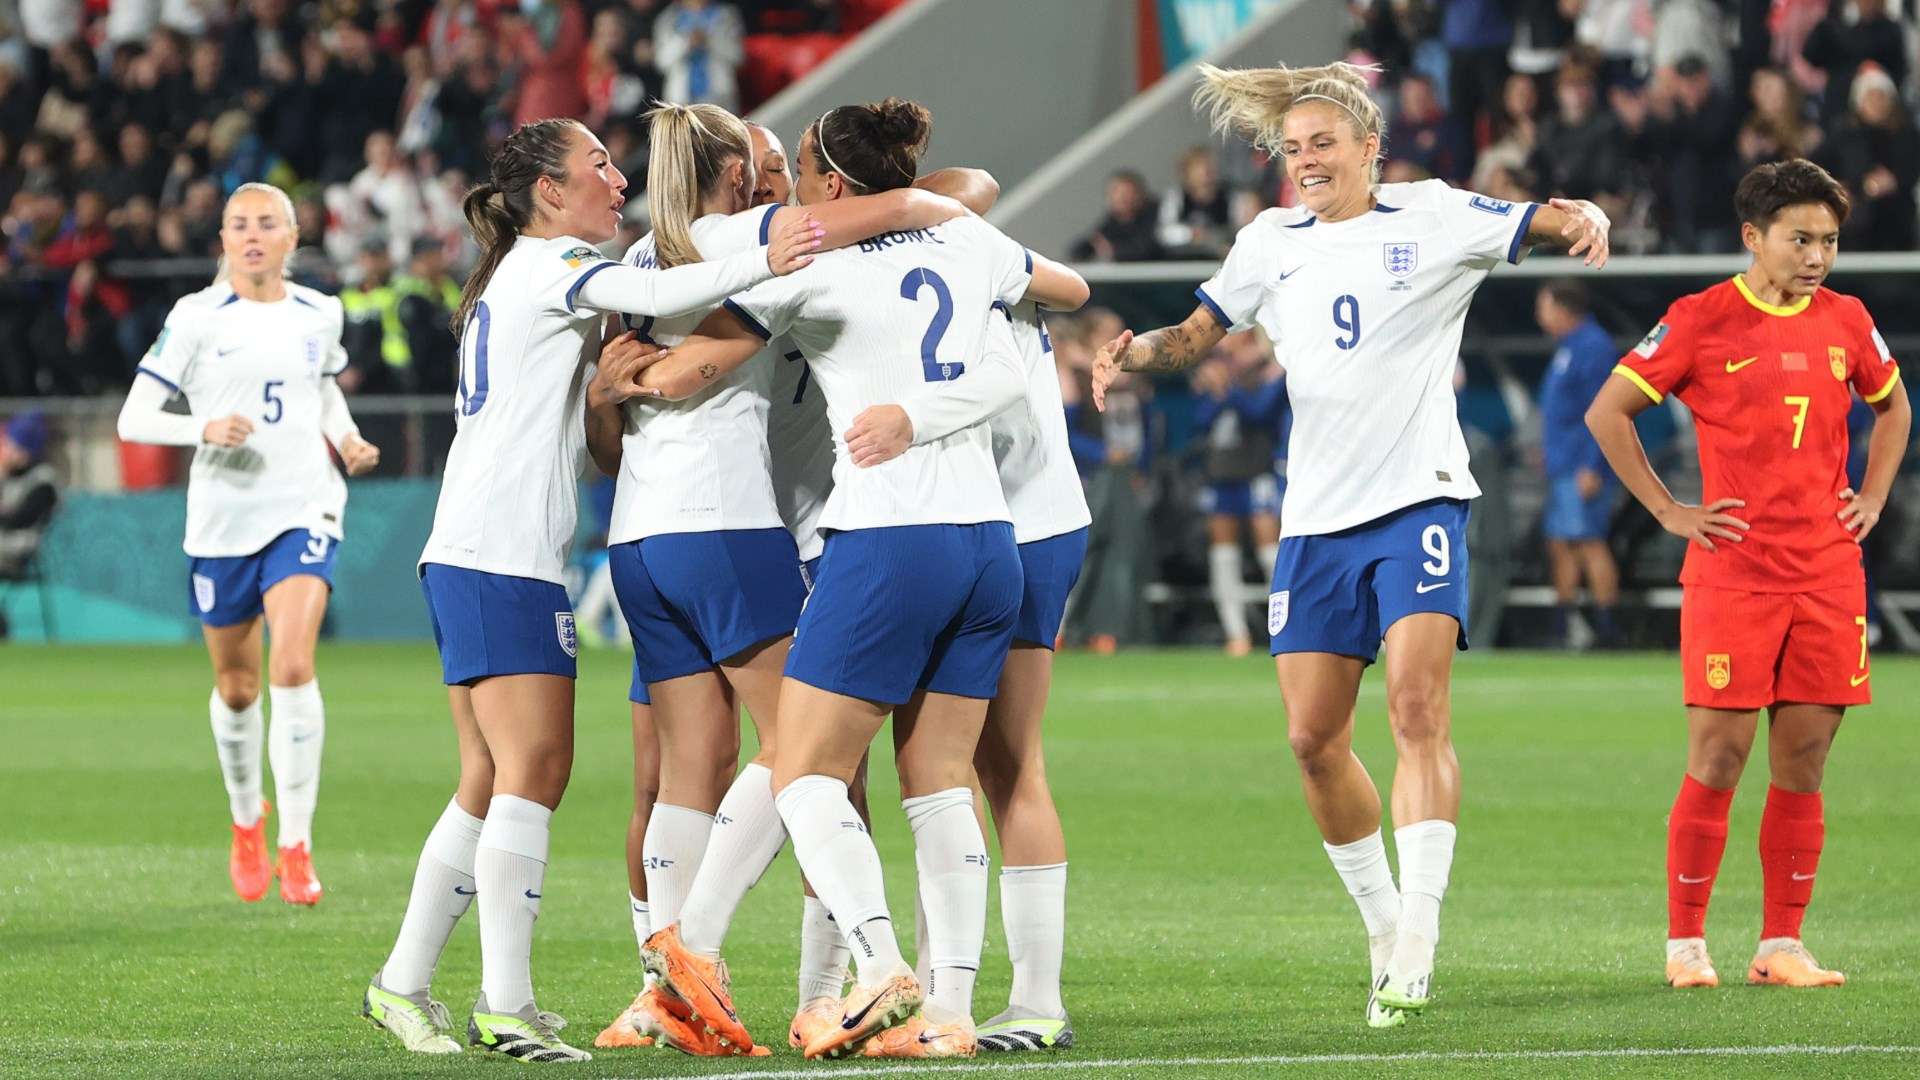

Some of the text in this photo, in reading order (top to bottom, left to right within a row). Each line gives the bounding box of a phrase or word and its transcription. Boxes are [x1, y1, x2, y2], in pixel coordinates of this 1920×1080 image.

[900, 266, 965, 382] 2
[1332, 294, 1361, 350] 9
[263, 380, 284, 424] 5
[784, 348, 811, 405] 7
[1783, 395, 1811, 449] 7
[1421, 523, 1451, 577] 9
[1855, 615, 1868, 671] 7
